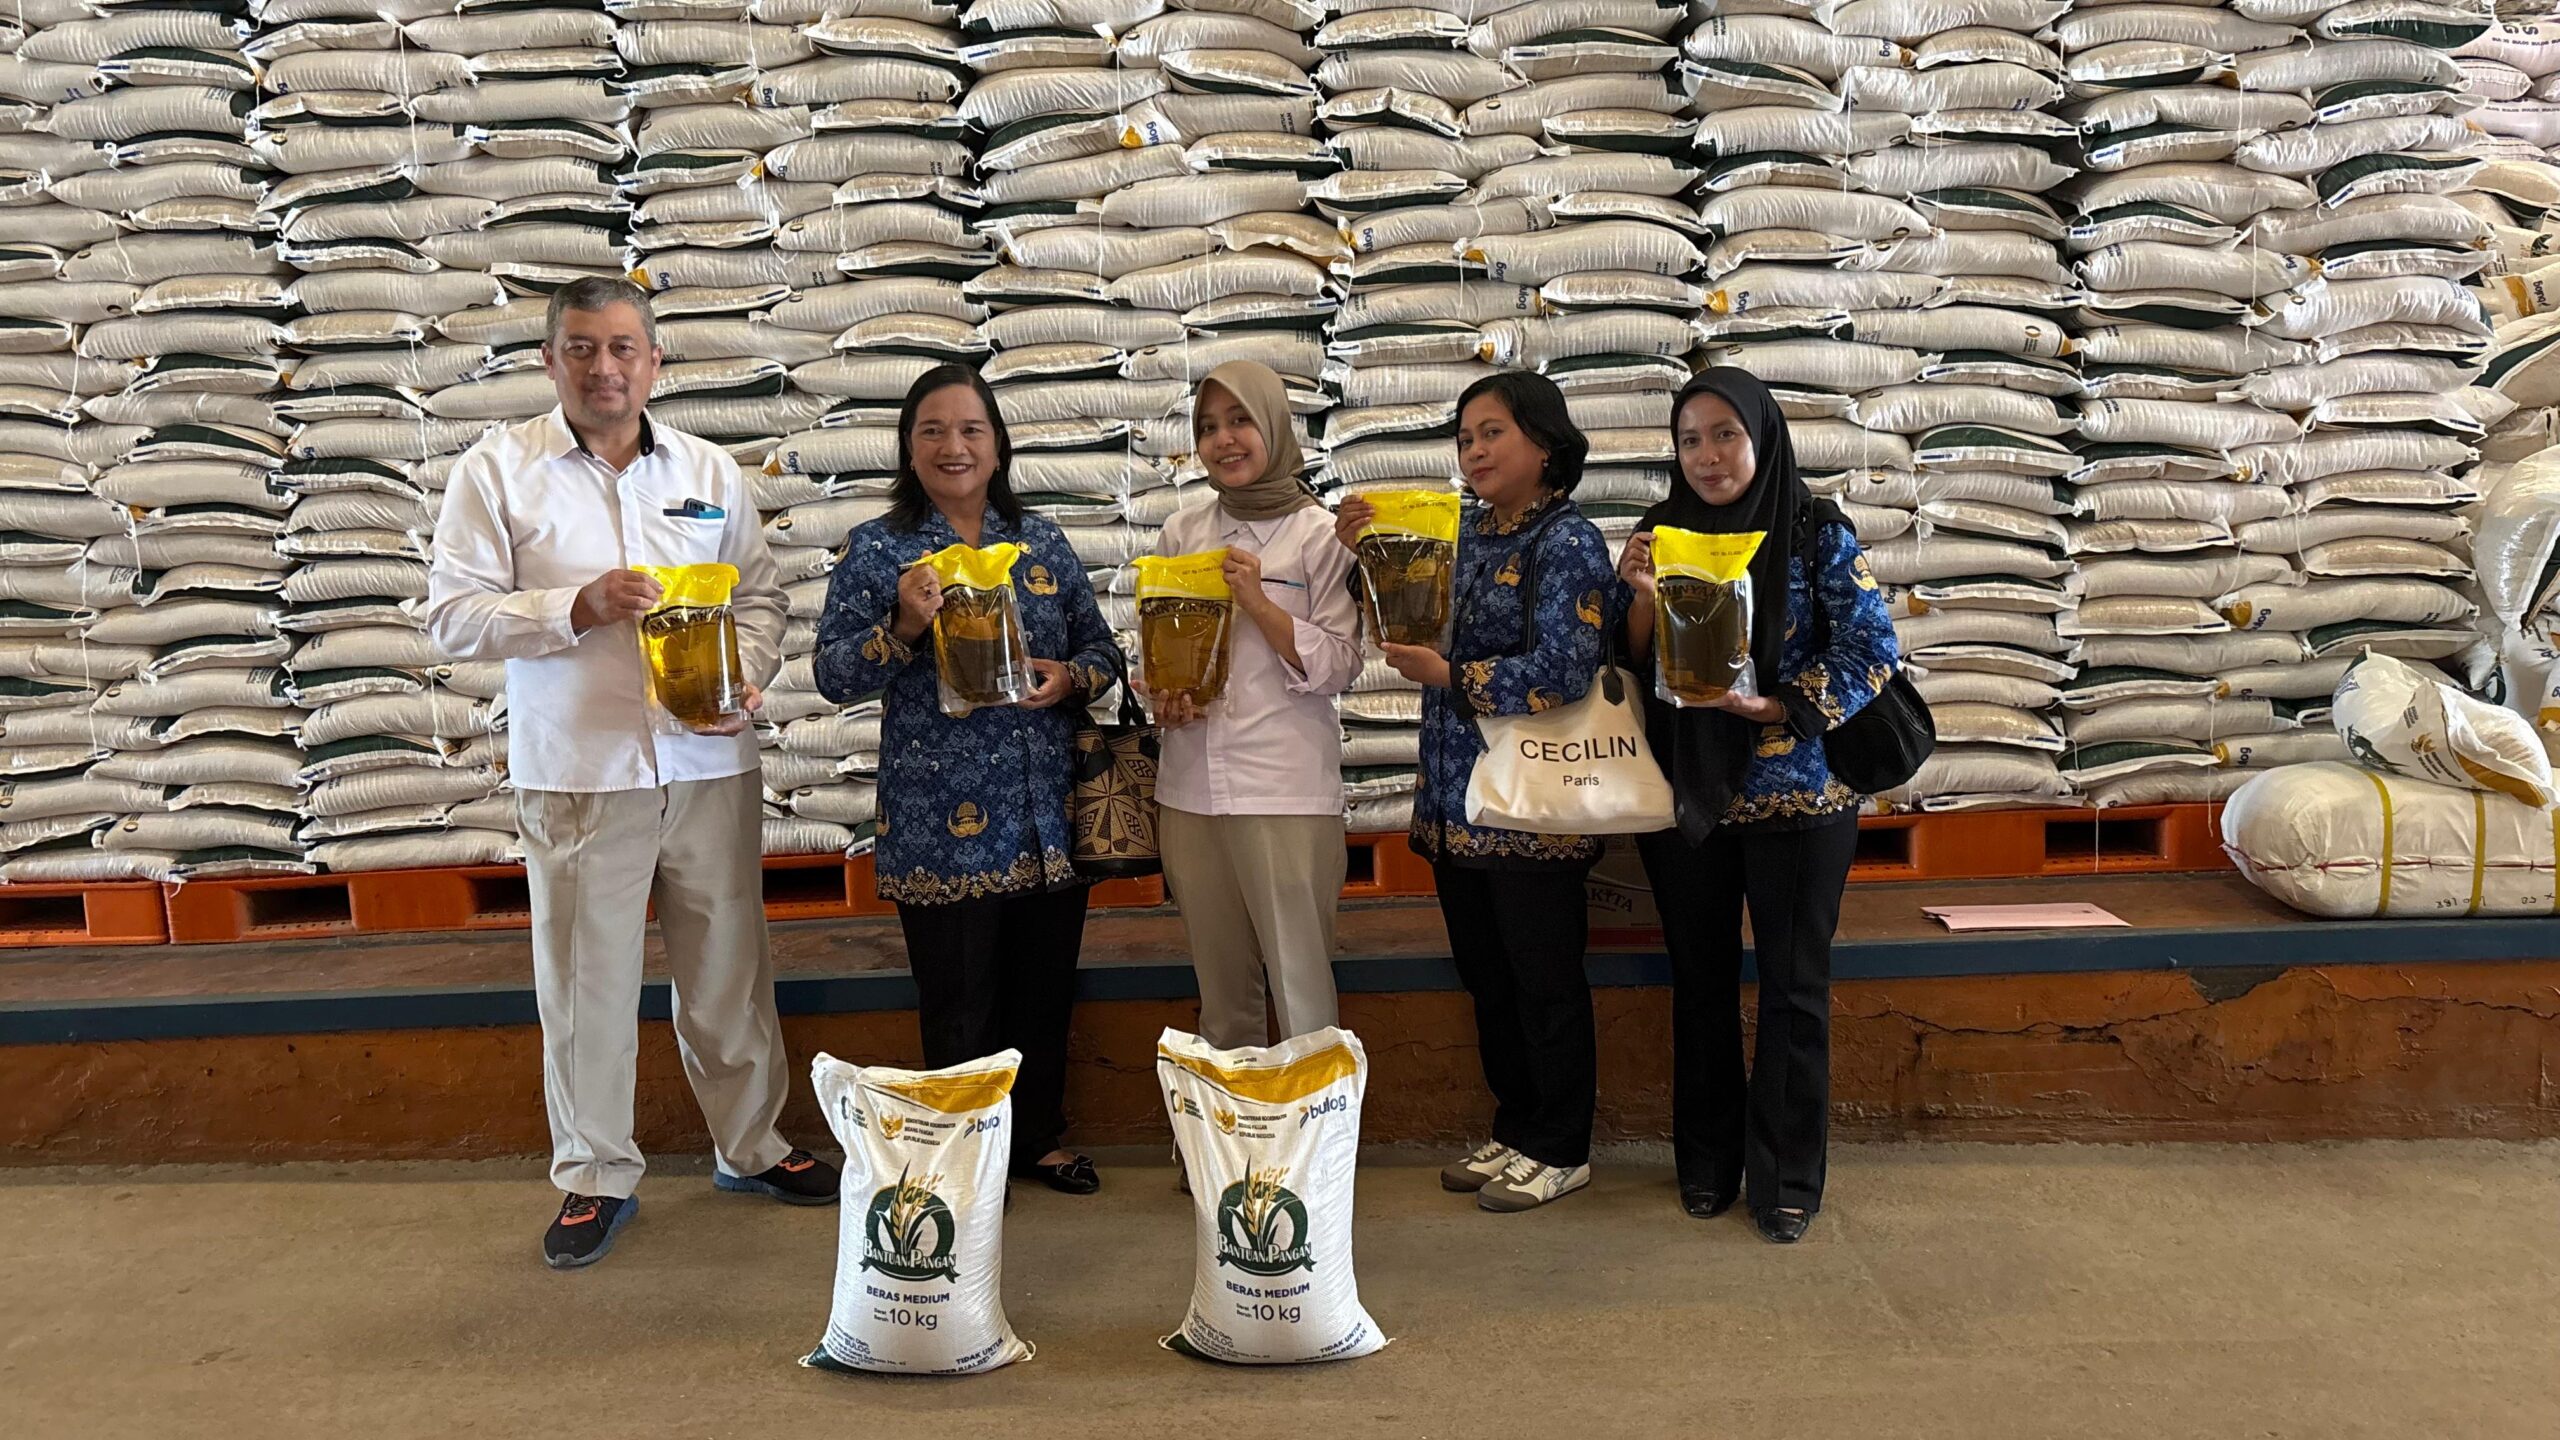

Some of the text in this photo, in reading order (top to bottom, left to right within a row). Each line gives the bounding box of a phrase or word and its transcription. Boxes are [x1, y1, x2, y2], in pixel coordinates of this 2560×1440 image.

[1146, 121, 1160, 146] ulog
[1520, 736, 1638, 762] CECILIN
[1563, 773, 1600, 786] Paris
[1310, 1095, 1347, 1119] bulog
[863, 1236, 956, 1269] BANTUAN PANGAN
[1218, 1231, 1311, 1264] BANTUAN PANGAN
[866, 1285, 950, 1304] BERAS MEDIUM
[1226, 1280, 1310, 1299] BERAS MEDIUM
[889, 1308, 938, 1330] 10 kg
[1252, 1304, 1300, 1323] 10 kg
[845, 1338, 871, 1354] BULOG
[1207, 1330, 1234, 1348] BULOG
[1320, 1340, 1344, 1353] TIDAK
[956, 1351, 981, 1364] TIDAK
